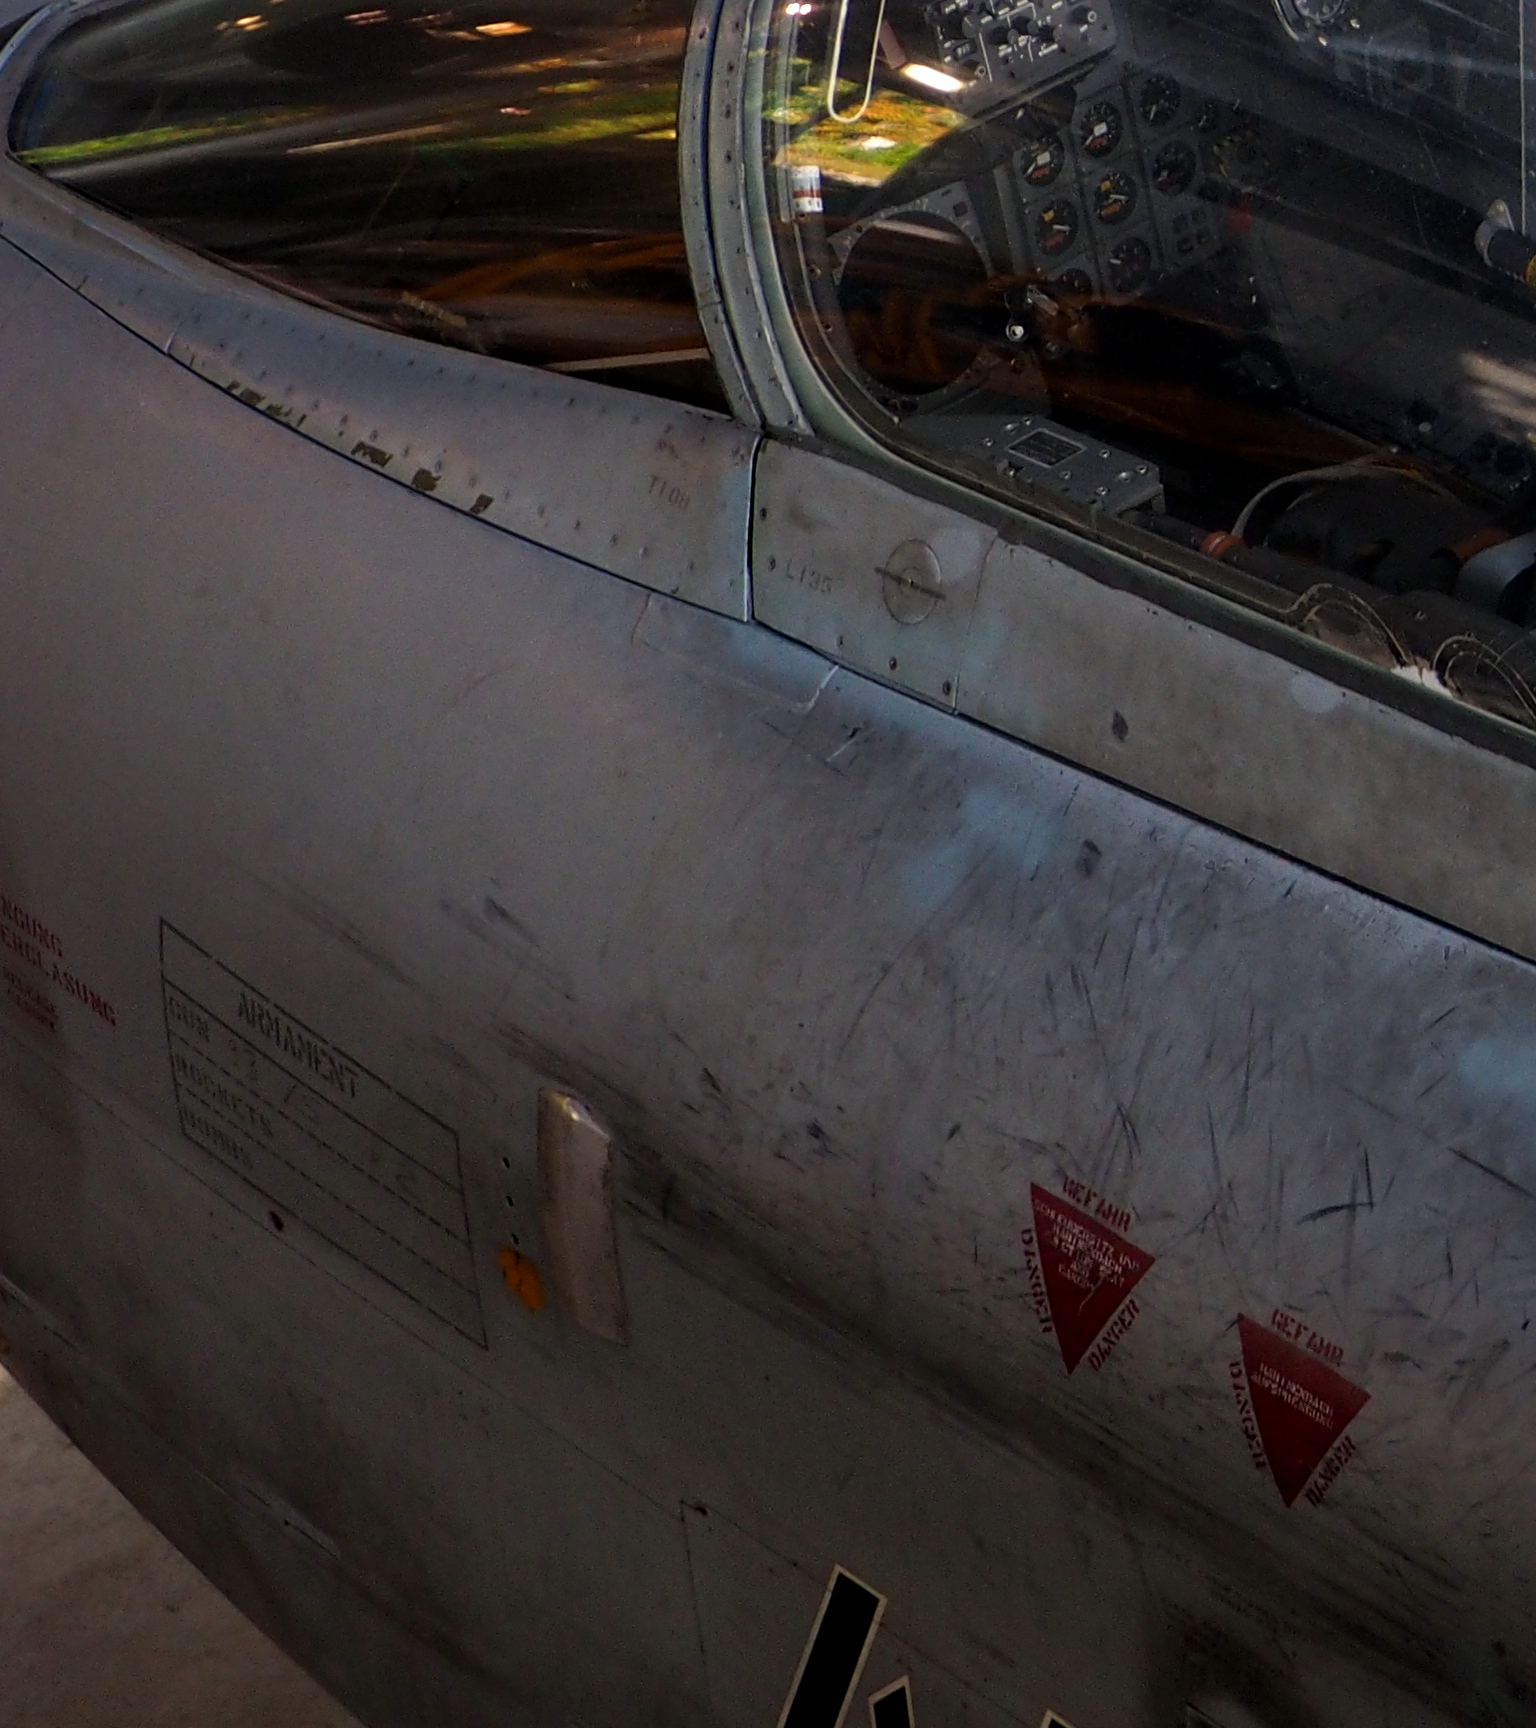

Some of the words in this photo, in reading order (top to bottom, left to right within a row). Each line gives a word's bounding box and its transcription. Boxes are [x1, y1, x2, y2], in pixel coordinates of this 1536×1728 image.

[238, 992, 359, 1098] ARMAMENT
[1063, 1176, 1131, 1233] GEFAHR
[1021, 1228, 1053, 1334] DANGER
[1087, 1298, 1140, 1372] DANGER
[1271, 1308, 1344, 1368] GEFAHR
[1229, 1361, 1267, 1469] DANGER
[1305, 1434, 1357, 1508] DANGER
